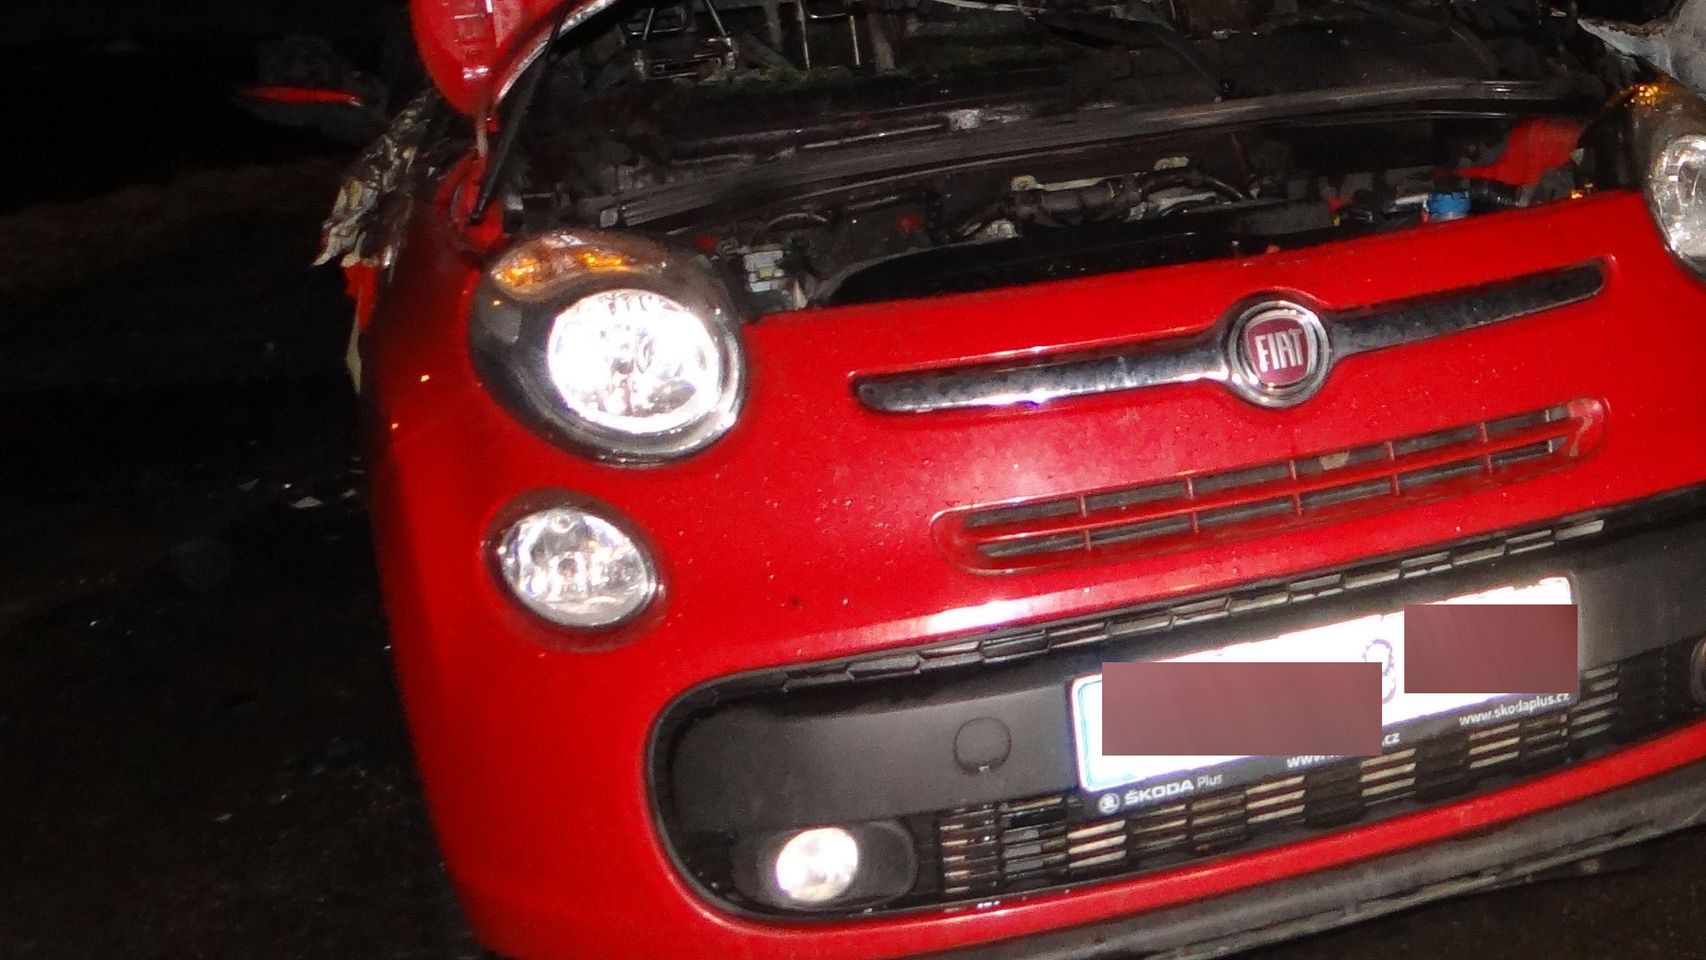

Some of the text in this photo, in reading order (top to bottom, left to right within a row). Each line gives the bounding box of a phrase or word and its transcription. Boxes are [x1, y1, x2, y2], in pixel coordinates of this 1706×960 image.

[1255, 328, 1304, 372] FIAT
[1459, 693, 1570, 726] www.skodaplus.cz
[1124, 773, 1224, 806] ŠKODA Plus
